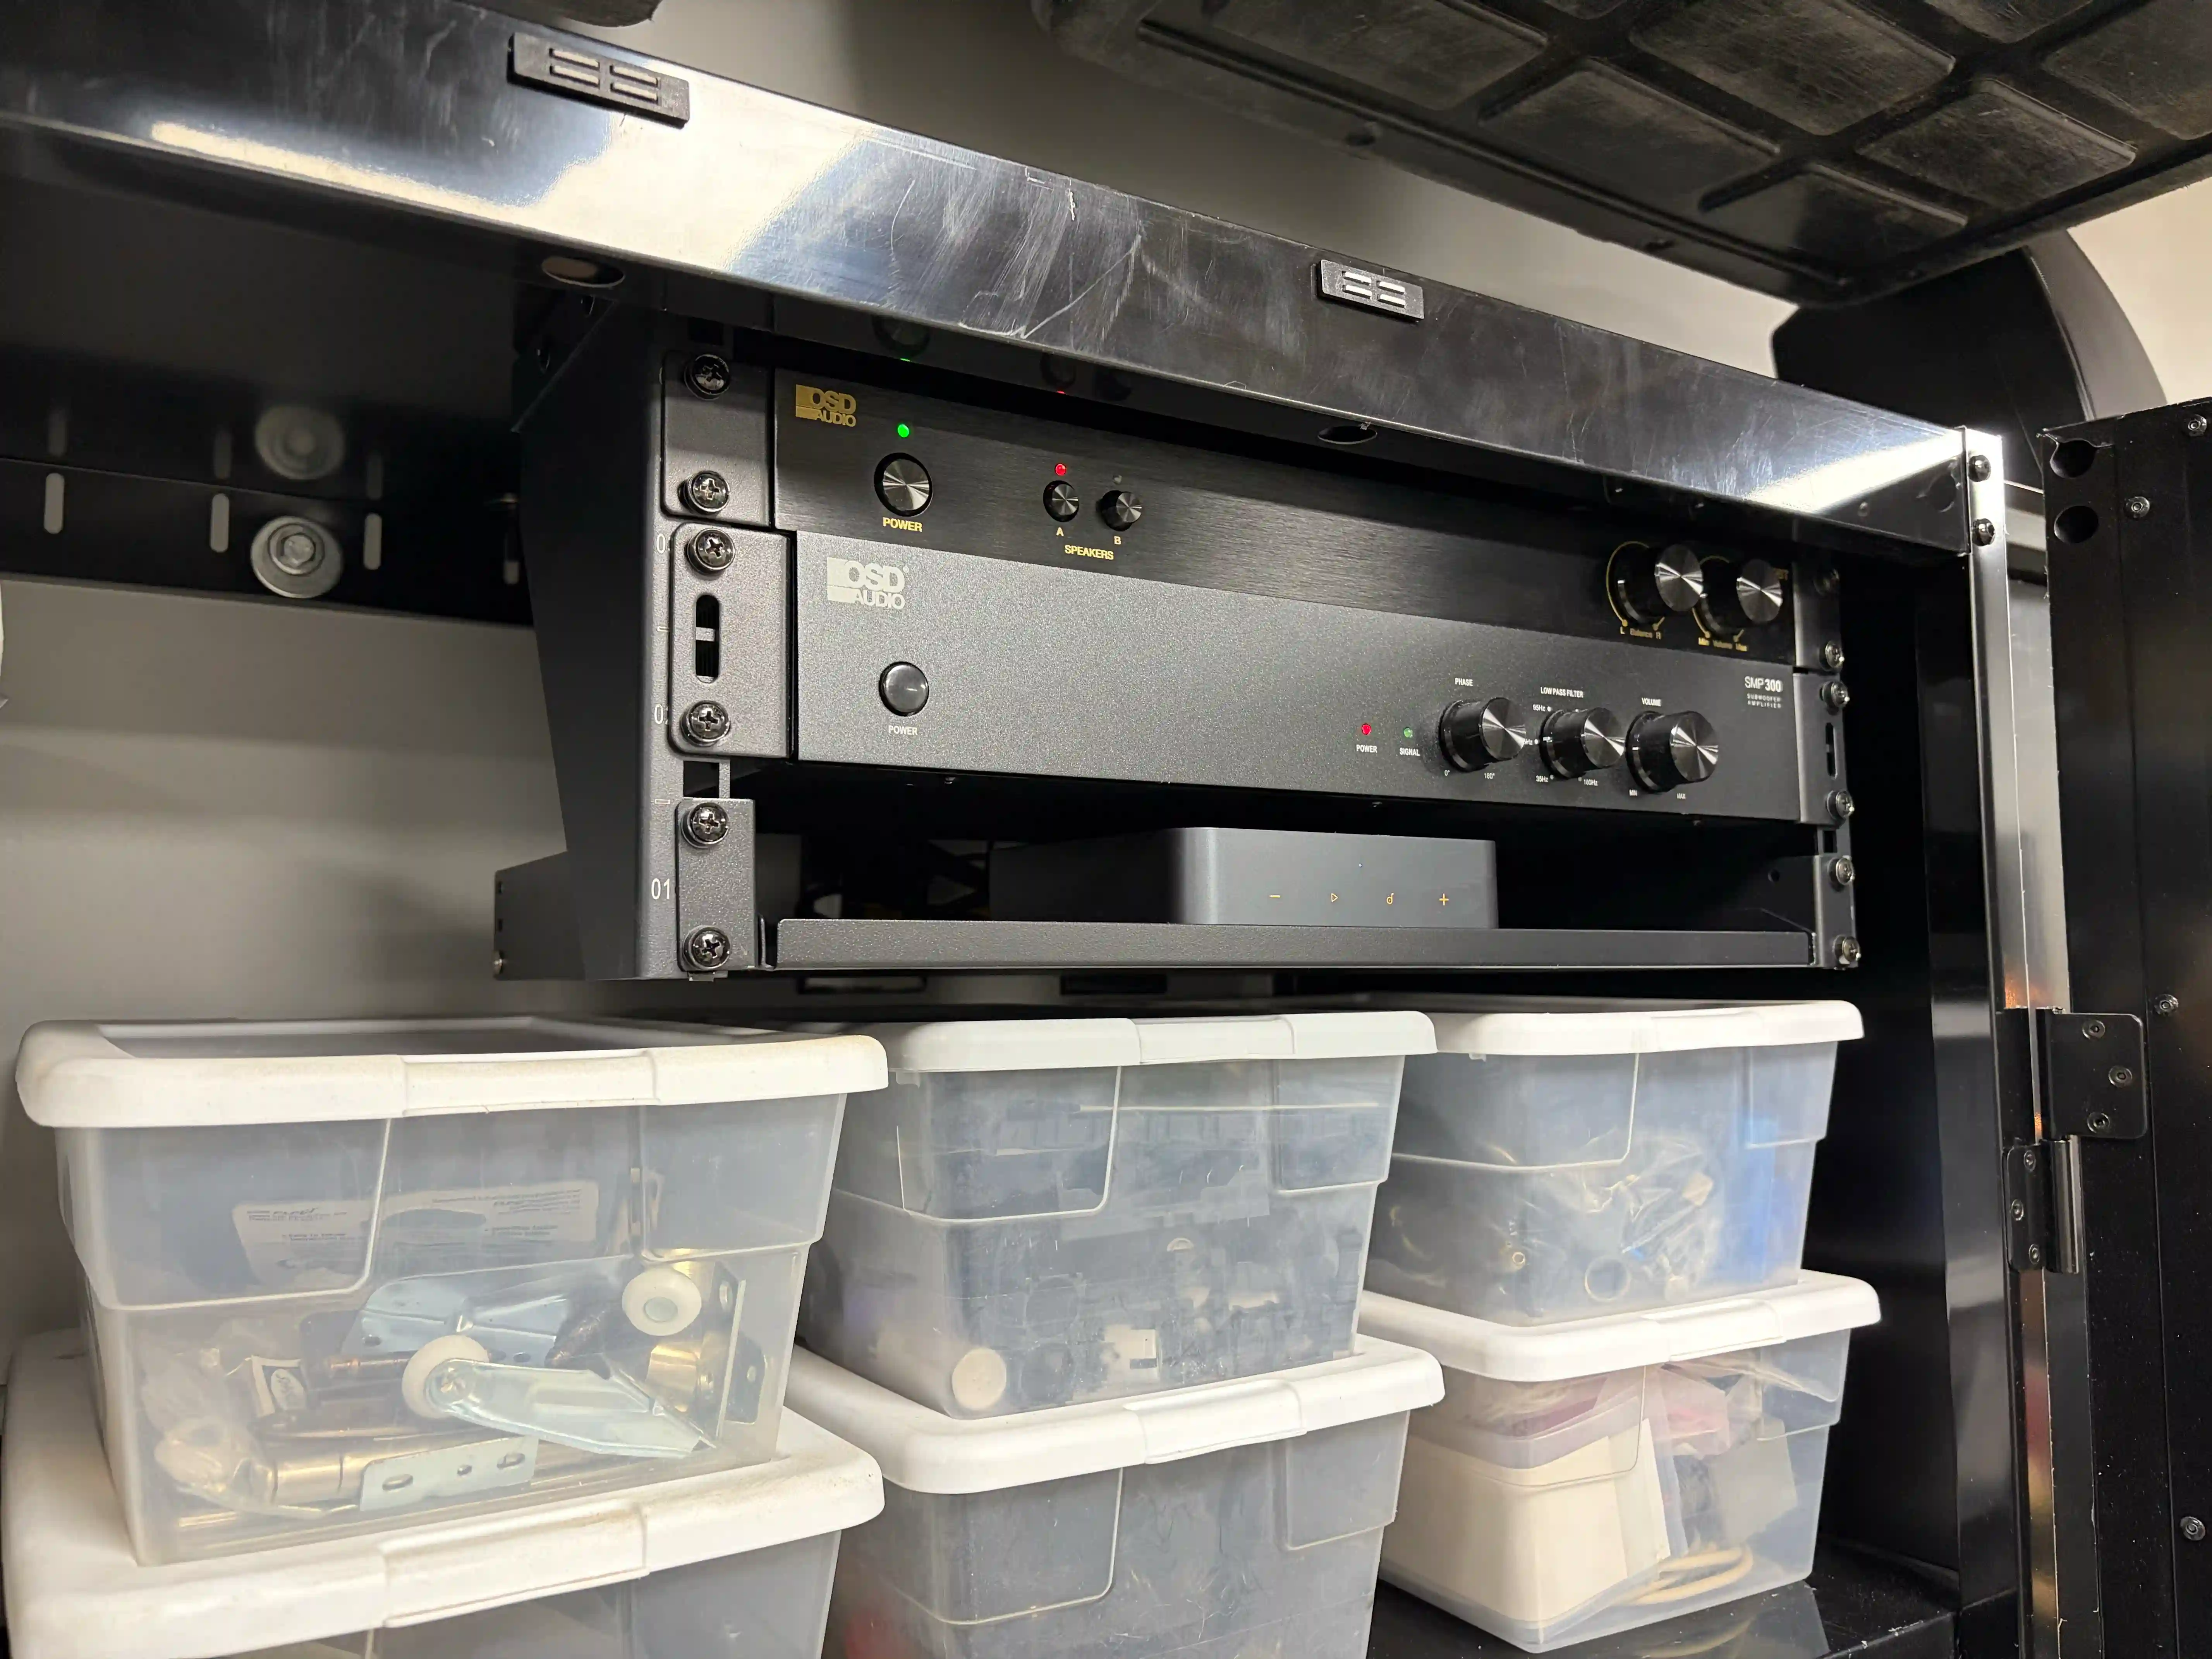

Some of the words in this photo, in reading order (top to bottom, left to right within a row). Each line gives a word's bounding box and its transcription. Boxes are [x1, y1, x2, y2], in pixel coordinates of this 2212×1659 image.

[809, 388, 856, 414] OSD
[815, 408, 856, 427] AUDIO
[883, 517, 922, 532] POWER
[1056, 527, 1063, 537] A
[1114, 536, 1121, 544] B
[1064, 544, 1114, 560] SPEAKERS
[845, 560, 905, 593] OSD
[853, 589, 905, 610] AUDIO
[1455, 678, 1473, 687] PHASE
[1745, 676, 1764, 689] SMP
[1765, 678, 1783, 692] 300
[1540, 687, 1552, 695] LOW
[1553, 688, 1566, 697] PASS
[1566, 689, 1583, 698] FILTER
[1642, 698, 1661, 706] VOLUME
[888, 725, 917, 735] POWER
[1356, 744, 1377, 753] POWER
[1399, 747, 1420, 756] SIGNAL
[651, 878, 670, 900] 01
